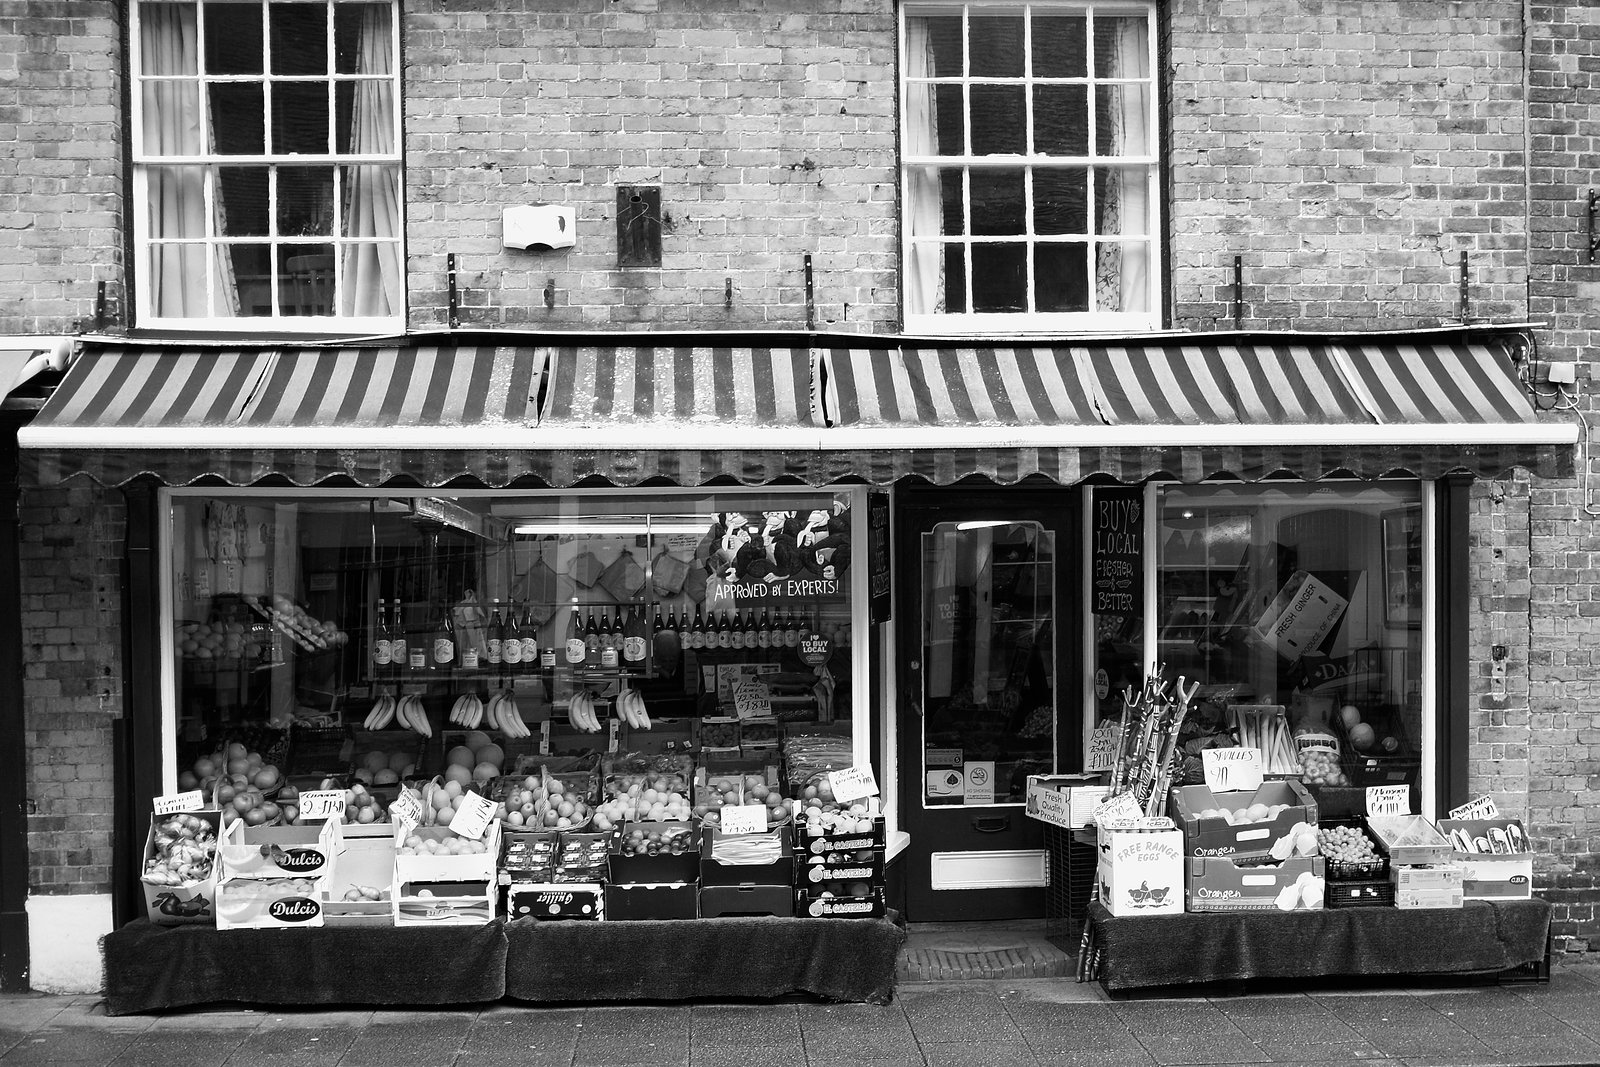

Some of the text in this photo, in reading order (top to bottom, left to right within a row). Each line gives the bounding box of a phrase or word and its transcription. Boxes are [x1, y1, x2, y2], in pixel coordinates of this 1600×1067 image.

[1099, 499, 1131, 534] BUY
[1096, 531, 1139, 555] LOCAL
[714, 579, 839, 601] APPROVED BY EXPERTS!
[1098, 592, 1133, 611] BETTER
[1275, 583, 1316, 638] FRESH GINGER
[1320, 660, 1369, 680] DAZA
[1297, 738, 1337, 752] JUMBO
[1213, 750, 1253, 761] SEVILLES
[1044, 791, 1062, 803] Fresh
[1041, 800, 1065, 816] Quality
[1040, 809, 1066, 825] Produce
[824, 838, 874, 850] IL CASTELLO
[1117, 842, 1142, 862] FREE
[1145, 841, 1180, 860] RANGE
[1137, 853, 1160, 862] EGGS
[1194, 846, 1236, 858] Orangen
[281, 852, 322, 866] Dulcis
[823, 867, 874, 879] IL CASTELLO
[1198, 887, 1241, 901] Orangen
[273, 901, 317, 916] Dulcis
[823, 902, 874, 913] IL CASTELLO
